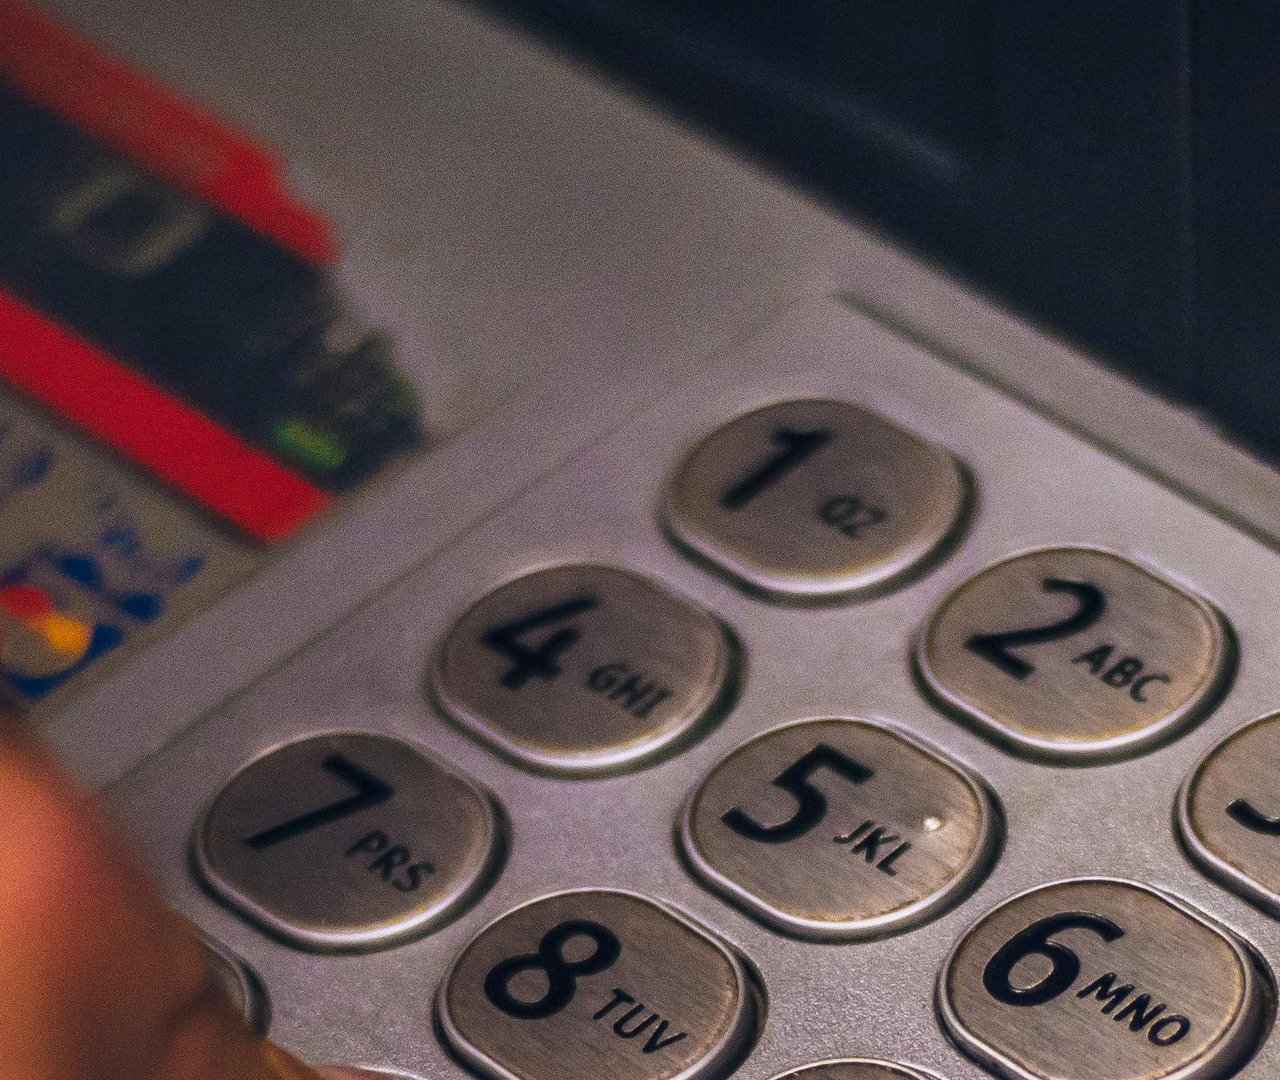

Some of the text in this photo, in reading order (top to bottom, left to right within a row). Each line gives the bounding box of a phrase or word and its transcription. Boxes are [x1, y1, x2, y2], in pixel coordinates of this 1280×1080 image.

[720, 424, 833, 509] 1
[480, 592, 670, 719] 4 GHI
[966, 578, 1174, 704] 2 ABC
[244, 753, 436, 893] 7 PRS
[720, 742, 910, 877] 5 JKL
[483, 918, 690, 1056] 8 TUV
[981, 911, 1192, 1048] 6 MNO
